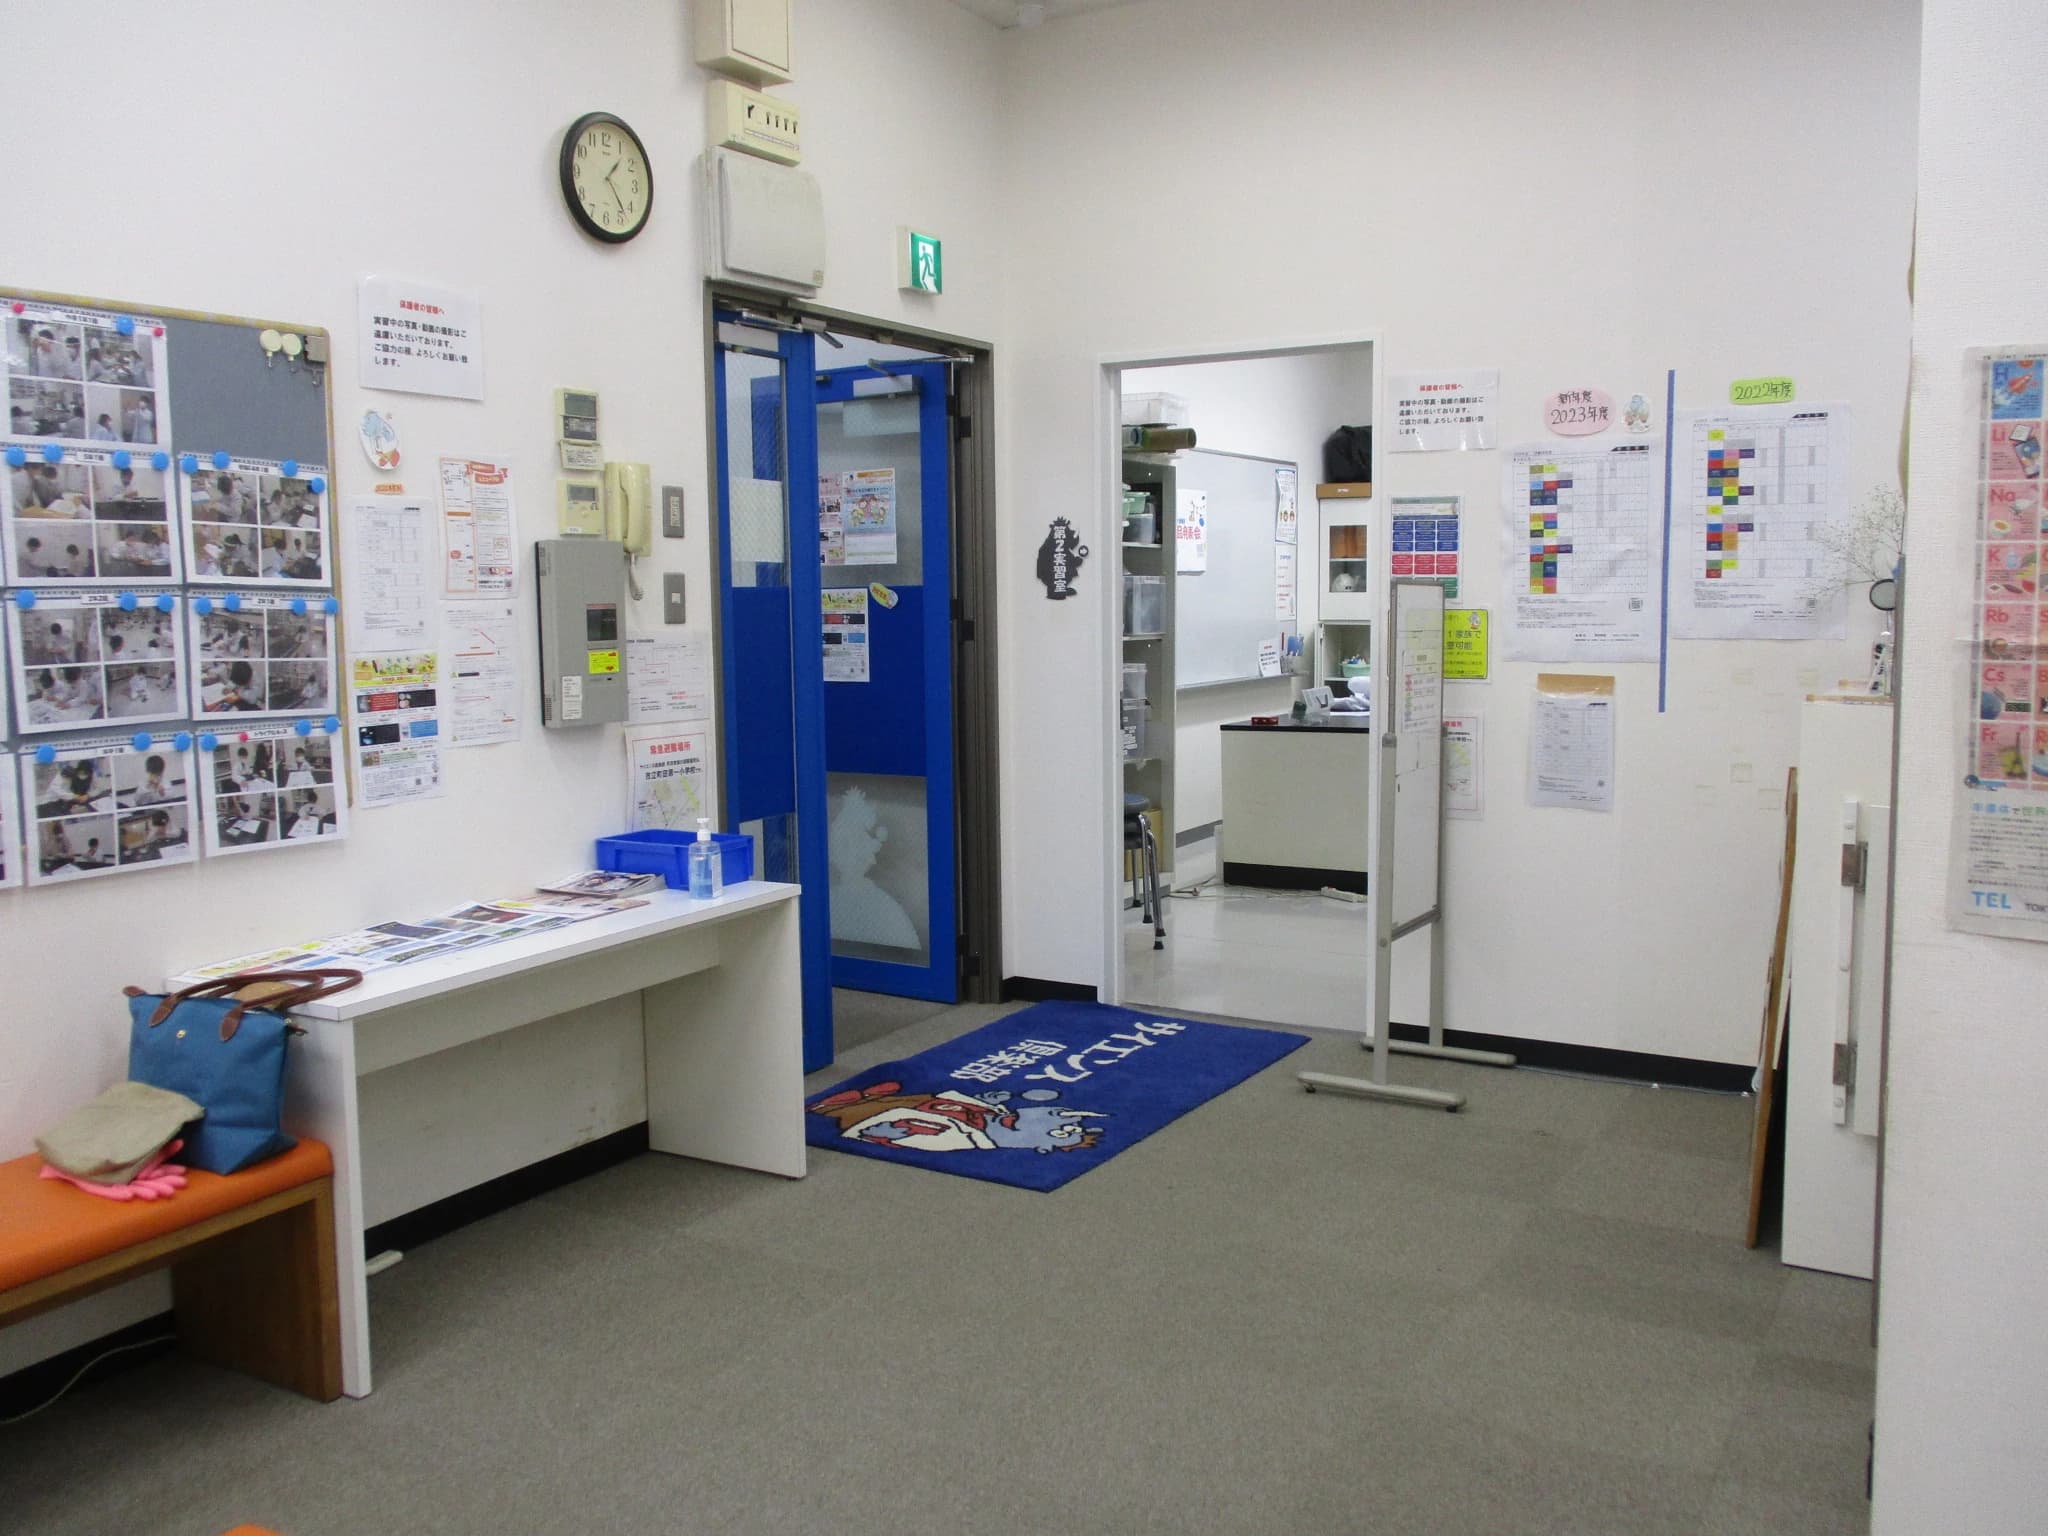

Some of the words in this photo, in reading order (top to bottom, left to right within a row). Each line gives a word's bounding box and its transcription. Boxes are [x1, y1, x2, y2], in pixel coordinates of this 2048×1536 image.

[589, 131, 596, 148] 11
[601, 131, 611, 148] 12
[577, 143, 587, 160] 10
[573, 163, 580, 179] 9
[627, 158, 635, 173] 2
[578, 185, 586, 201] 8
[631, 179, 639, 194] 3
[588, 202, 596, 219] 7
[627, 200, 633, 214] 4
[602, 210, 610, 226] 6
[1734, 381, 1793, 401] 2022年度
[1551, 405, 1610, 426] 2023年度
[1992, 428, 2006, 442] Li
[1990, 488, 2016, 503] Na
[1053, 525, 1067, 593] 第2実習室
[1987, 548, 2001, 562] K
[1986, 608, 2009, 623] Rb
[1983, 667, 2005, 682] Cs
[1982, 727, 1997, 741] Fr
[1971, 890, 2012, 910] TEL
[1024, 1020, 1186, 1084] サイエンス
[948, 1038, 1068, 1083] 倶楽部
